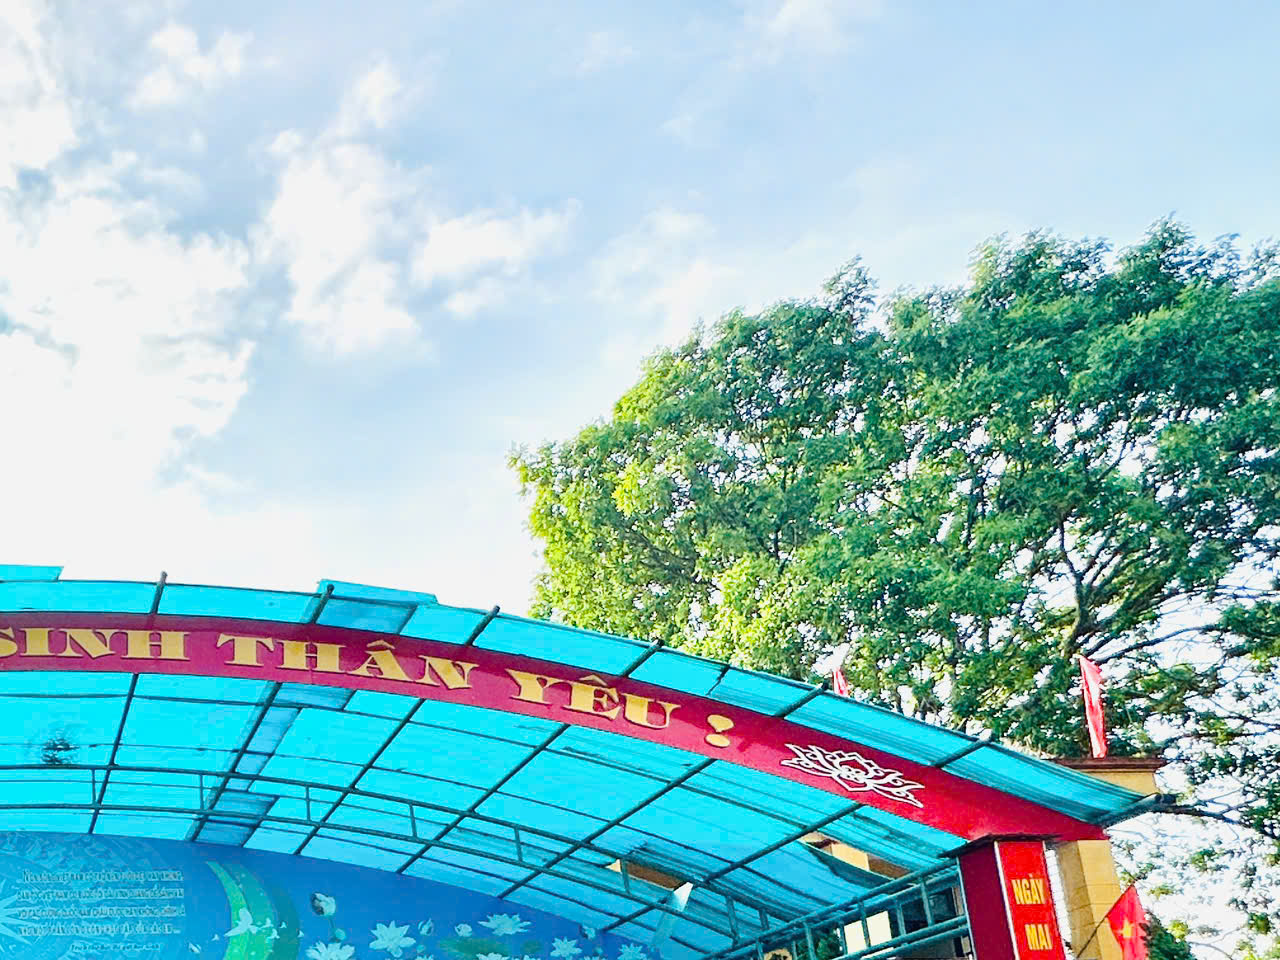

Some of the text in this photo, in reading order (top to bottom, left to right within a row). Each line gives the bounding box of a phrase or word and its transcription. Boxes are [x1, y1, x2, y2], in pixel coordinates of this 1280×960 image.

[217, 634, 477, 690] THÂN
[507, 670, 679, 730] YÊU
[1012, 875, 1045, 905] NGÀY
[1024, 923, 1053, 951] MAI
